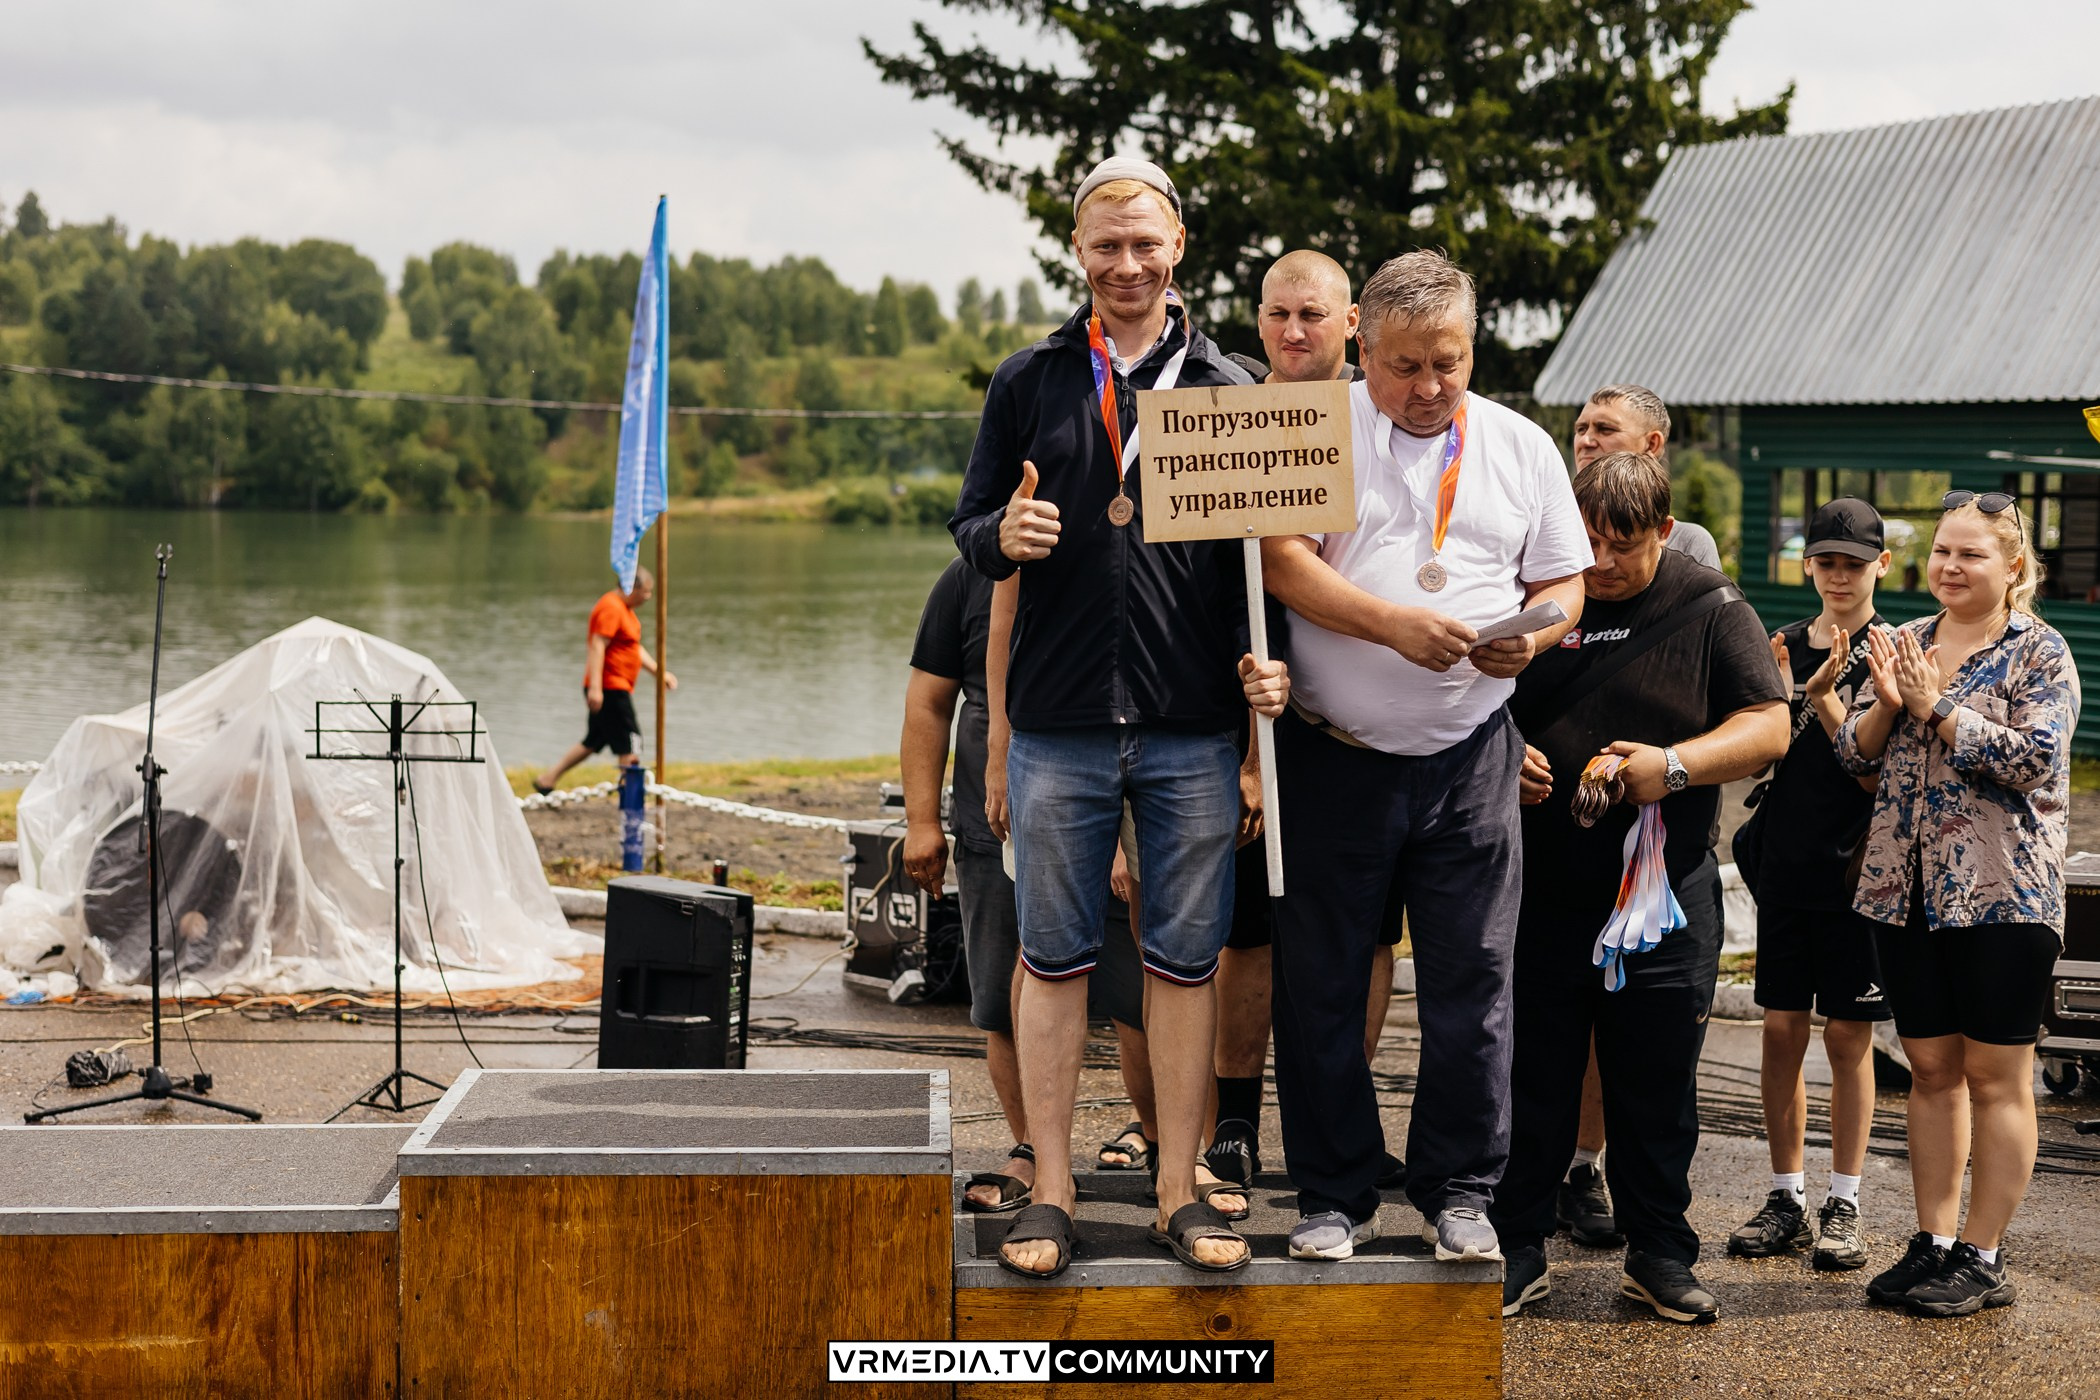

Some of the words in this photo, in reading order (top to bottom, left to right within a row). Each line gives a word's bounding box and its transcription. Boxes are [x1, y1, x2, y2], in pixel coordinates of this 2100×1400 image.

[1161, 407, 1328, 438] Погрузочно-
[1153, 446, 1340, 480] транспортное
[1169, 486, 1328, 520] управление
[1207, 1140, 1250, 1159] NIKE
